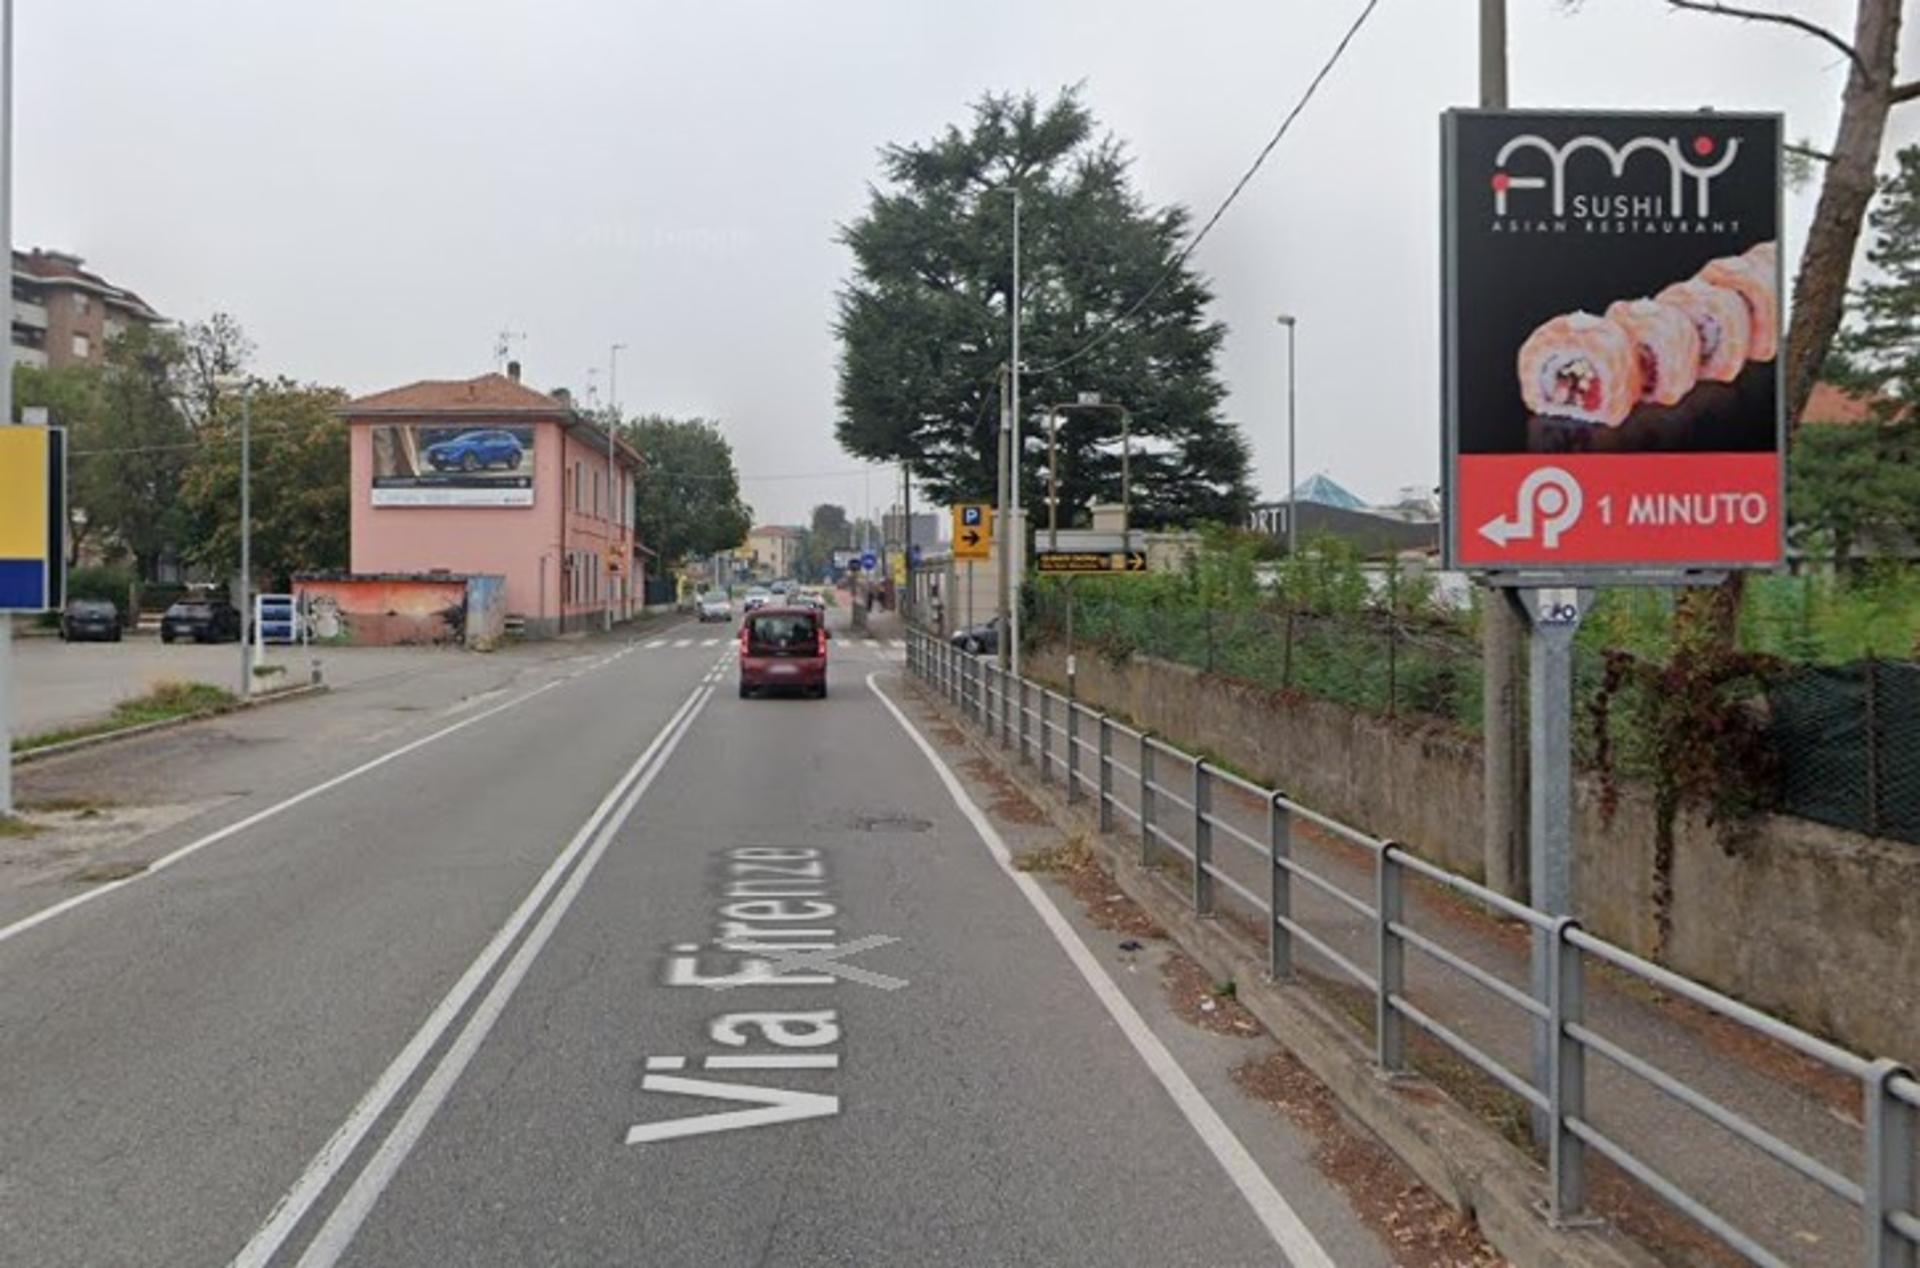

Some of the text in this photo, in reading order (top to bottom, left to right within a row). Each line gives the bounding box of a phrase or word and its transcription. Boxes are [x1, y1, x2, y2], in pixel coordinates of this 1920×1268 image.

[1491, 134, 1739, 218] AMY
[1573, 194, 1663, 218] SUSHI
[1491, 220, 1740, 233] ASIAN RESTAURANT
[1597, 492, 1768, 525] 1 MINUTO
